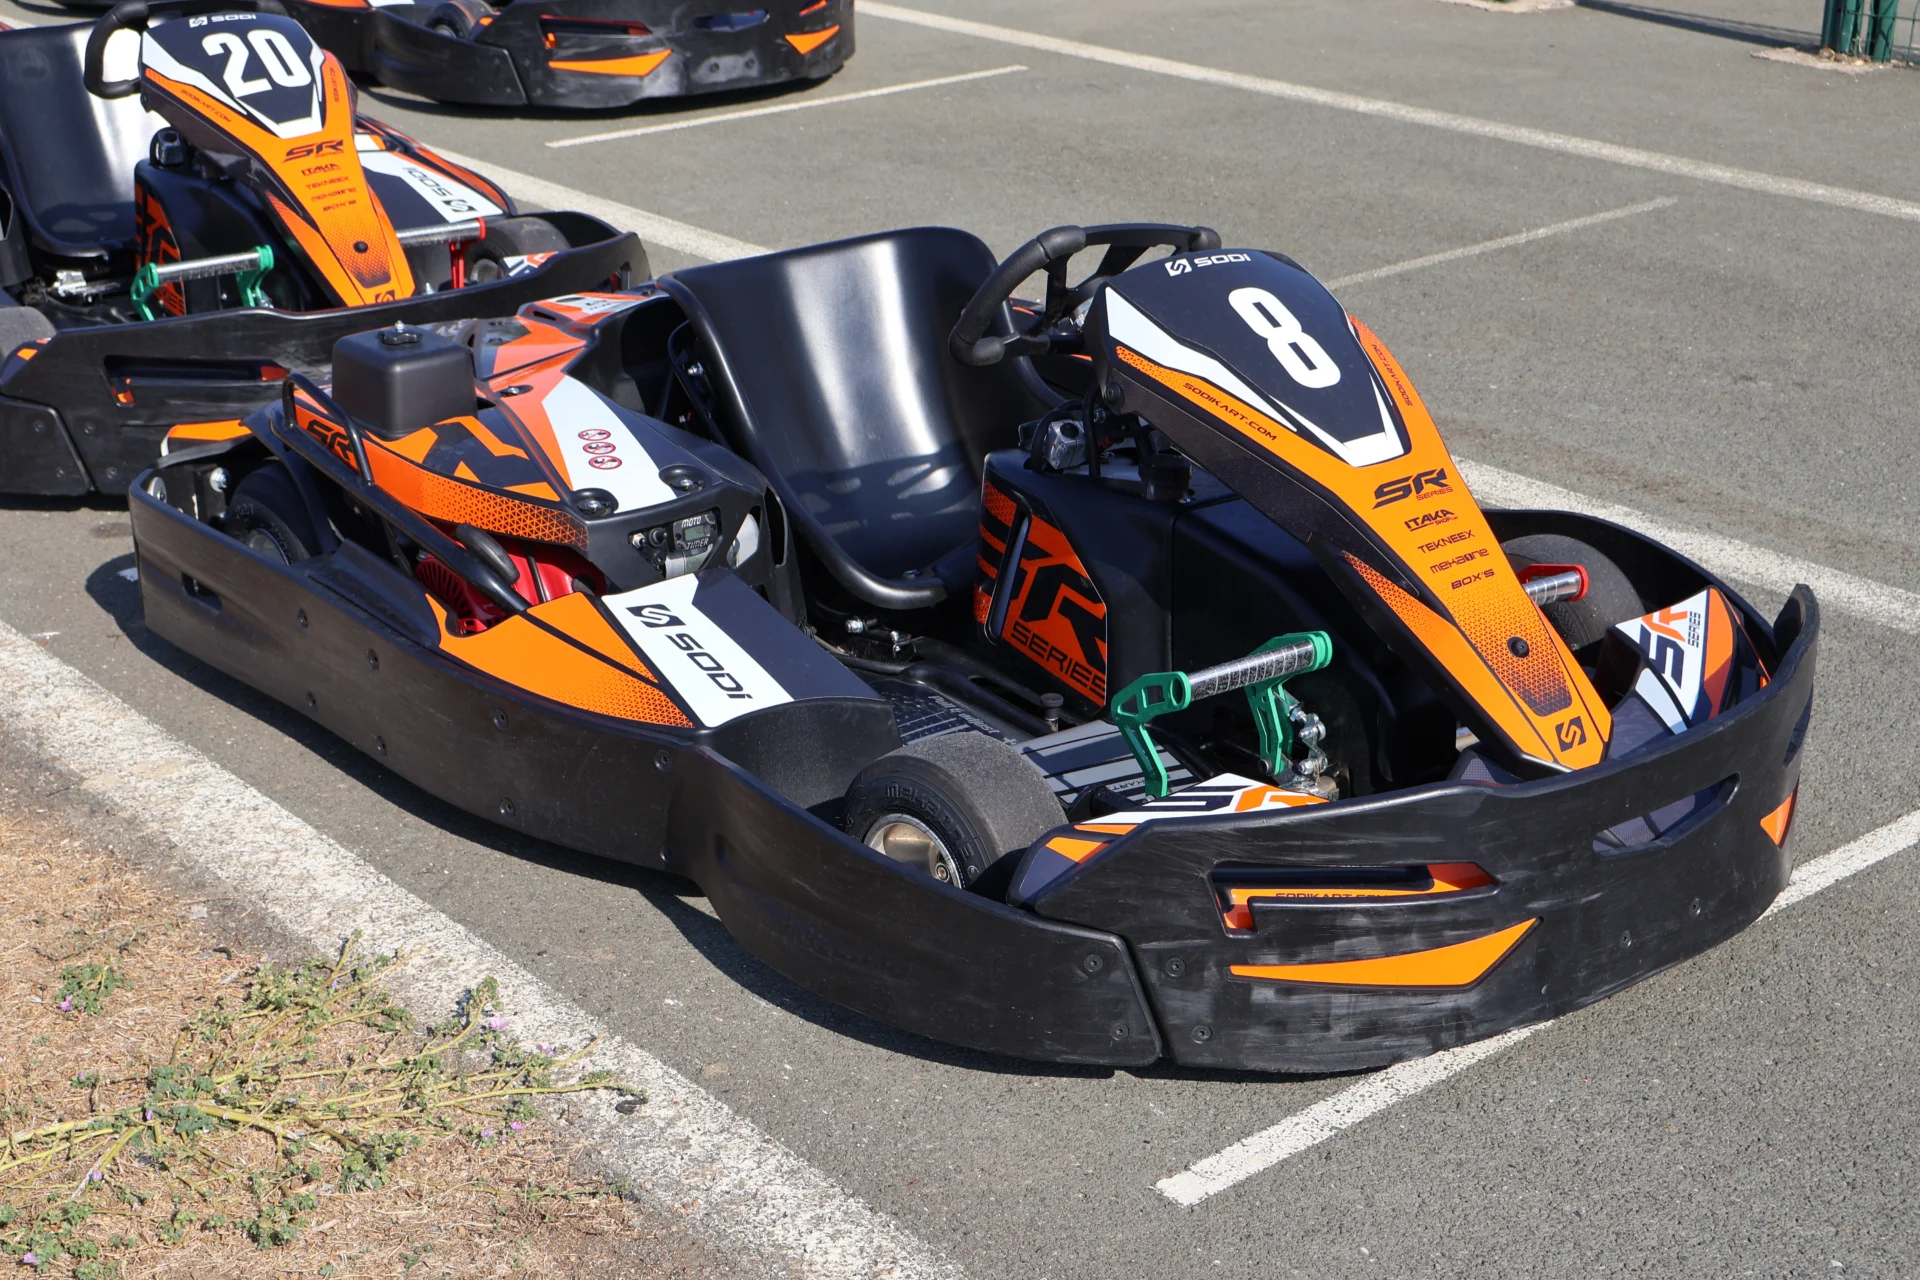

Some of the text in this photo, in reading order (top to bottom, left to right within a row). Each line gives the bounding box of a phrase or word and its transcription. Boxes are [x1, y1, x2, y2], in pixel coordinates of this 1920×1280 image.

[211, 14, 257, 23] SODI
[202, 29, 312, 98] 20
[282, 139, 344, 163] SR
[1193, 253, 1251, 267] SODI
[1228, 287, 1341, 389] 8
[1371, 344, 1413, 406] SODIKART.COM
[1183, 382, 1278, 441] SODIKART.COM
[1372, 467, 1450, 510] SR
[1416, 486, 1454, 501] SERIES
[681, 516, 702, 528] MOTO
[1403, 509, 1455, 530] ITAKA
[686, 537, 709, 550] TIMER
[1417, 529, 1476, 554] TEKNEEX
[1451, 568, 1495, 590] BOX'S
[1687, 610, 1701, 648] SERIES
[664, 633, 754, 699] SODI
[1010, 620, 1106, 700] SERIES
